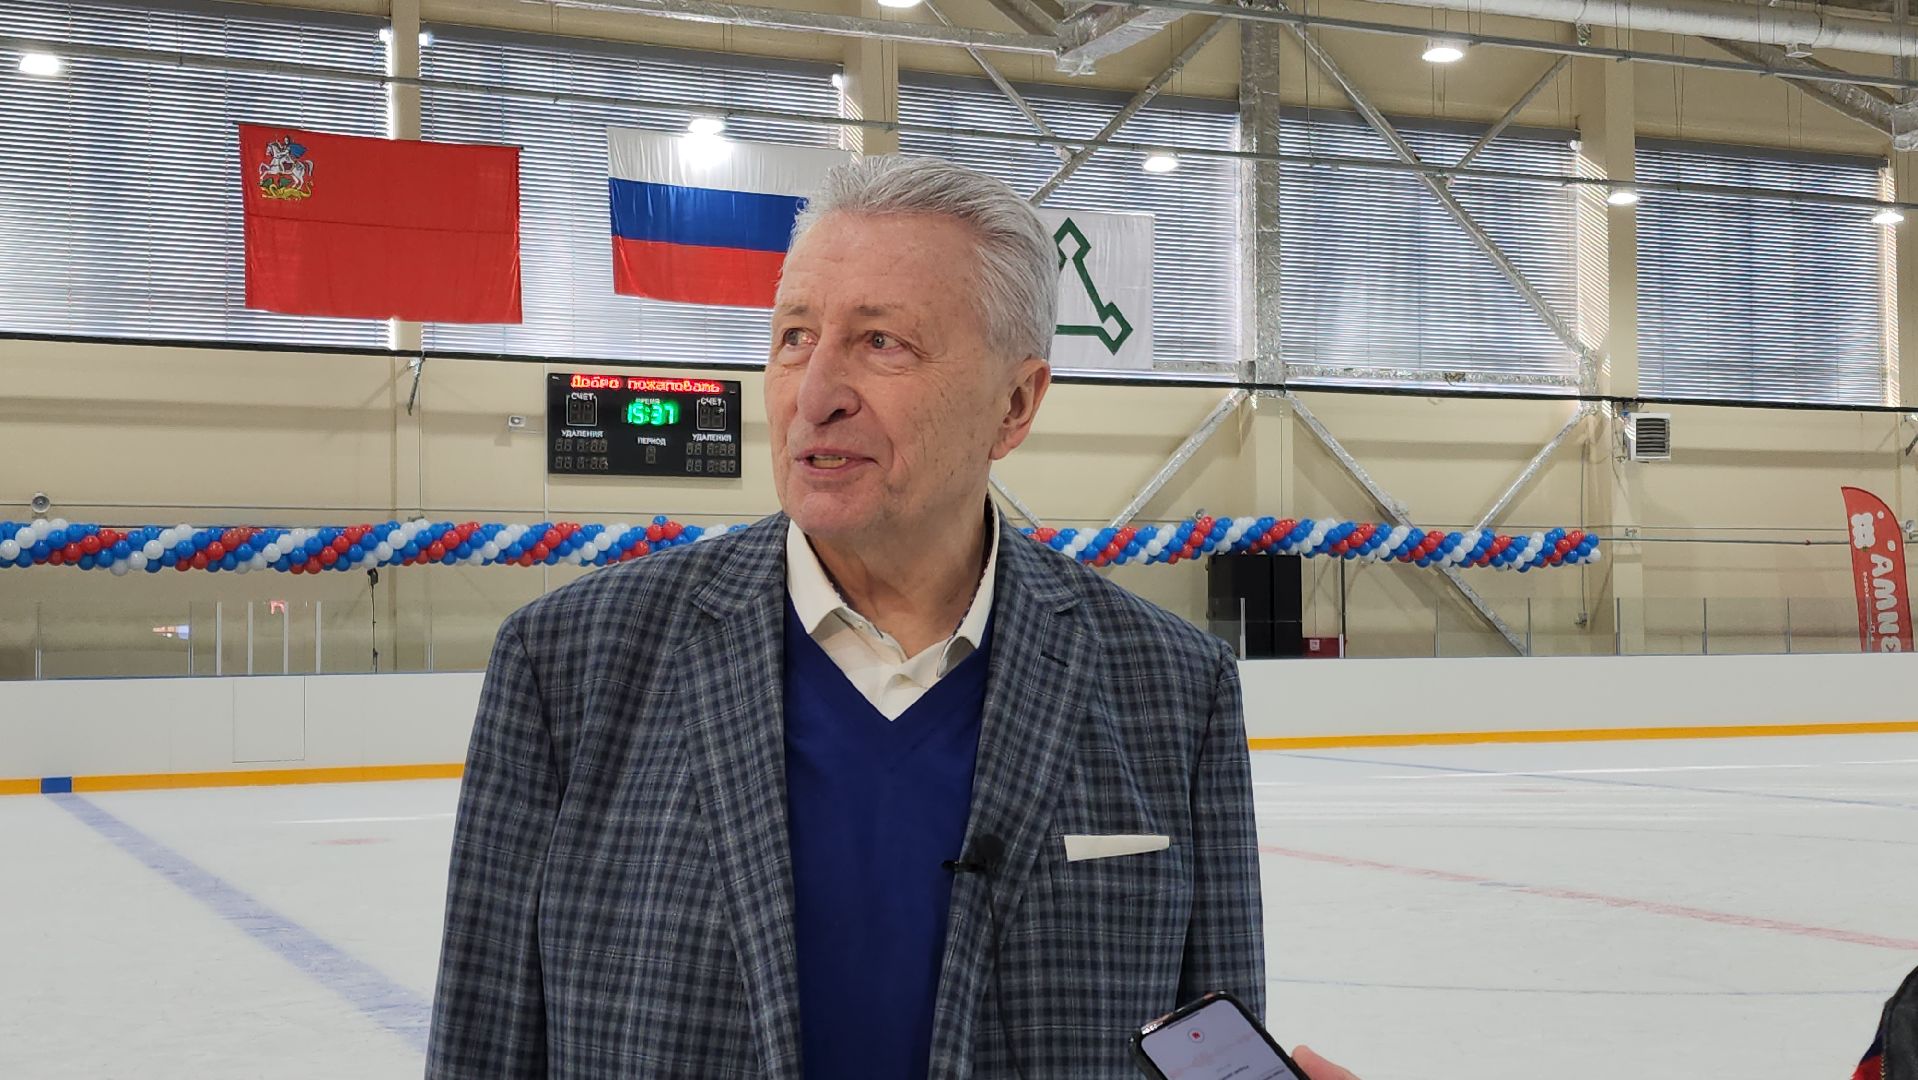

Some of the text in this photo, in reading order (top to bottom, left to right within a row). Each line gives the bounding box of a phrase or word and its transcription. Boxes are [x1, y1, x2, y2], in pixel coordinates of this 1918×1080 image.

[570, 375, 620, 389] Добро
[571, 392, 595, 401] СЧЕТ
[700, 397, 722, 407] СЧЕТ
[627, 403, 675, 425] 15:37
